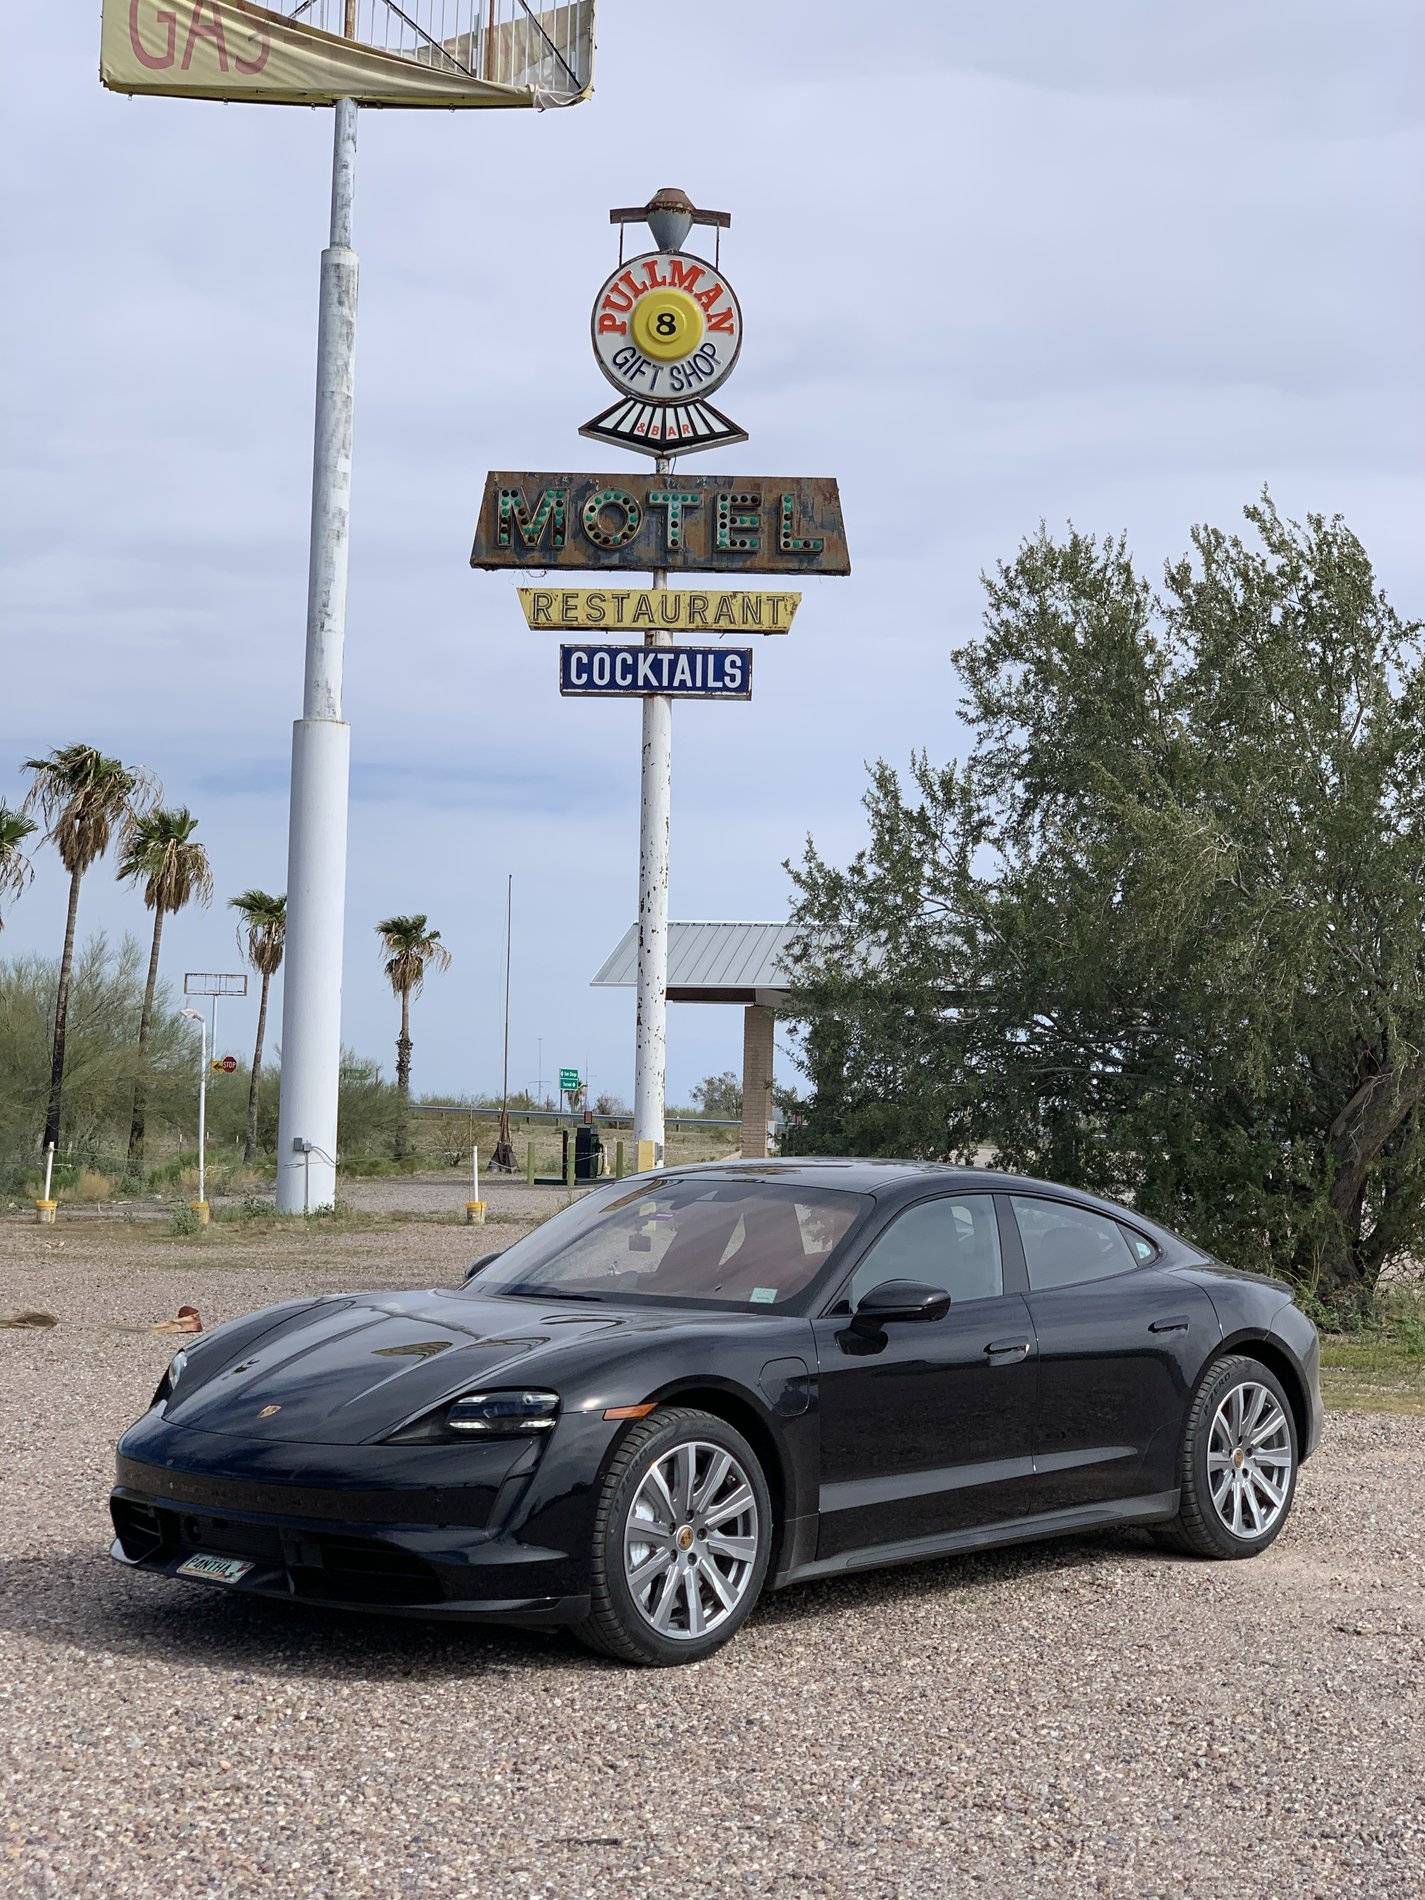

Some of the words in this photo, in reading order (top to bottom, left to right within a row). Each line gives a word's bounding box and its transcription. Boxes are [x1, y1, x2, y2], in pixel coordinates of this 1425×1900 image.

[599, 259, 735, 336] PULLMAN
[656, 313, 676, 336] 8
[612, 346, 664, 392] GIFT
[669, 342, 723, 392] SHOP
[497, 486, 826, 554] MOTEL
[531, 592, 787, 626] RESTAURANT
[569, 651, 742, 689] COCKTAILS
[224, 1061, 236, 1069] STOP
